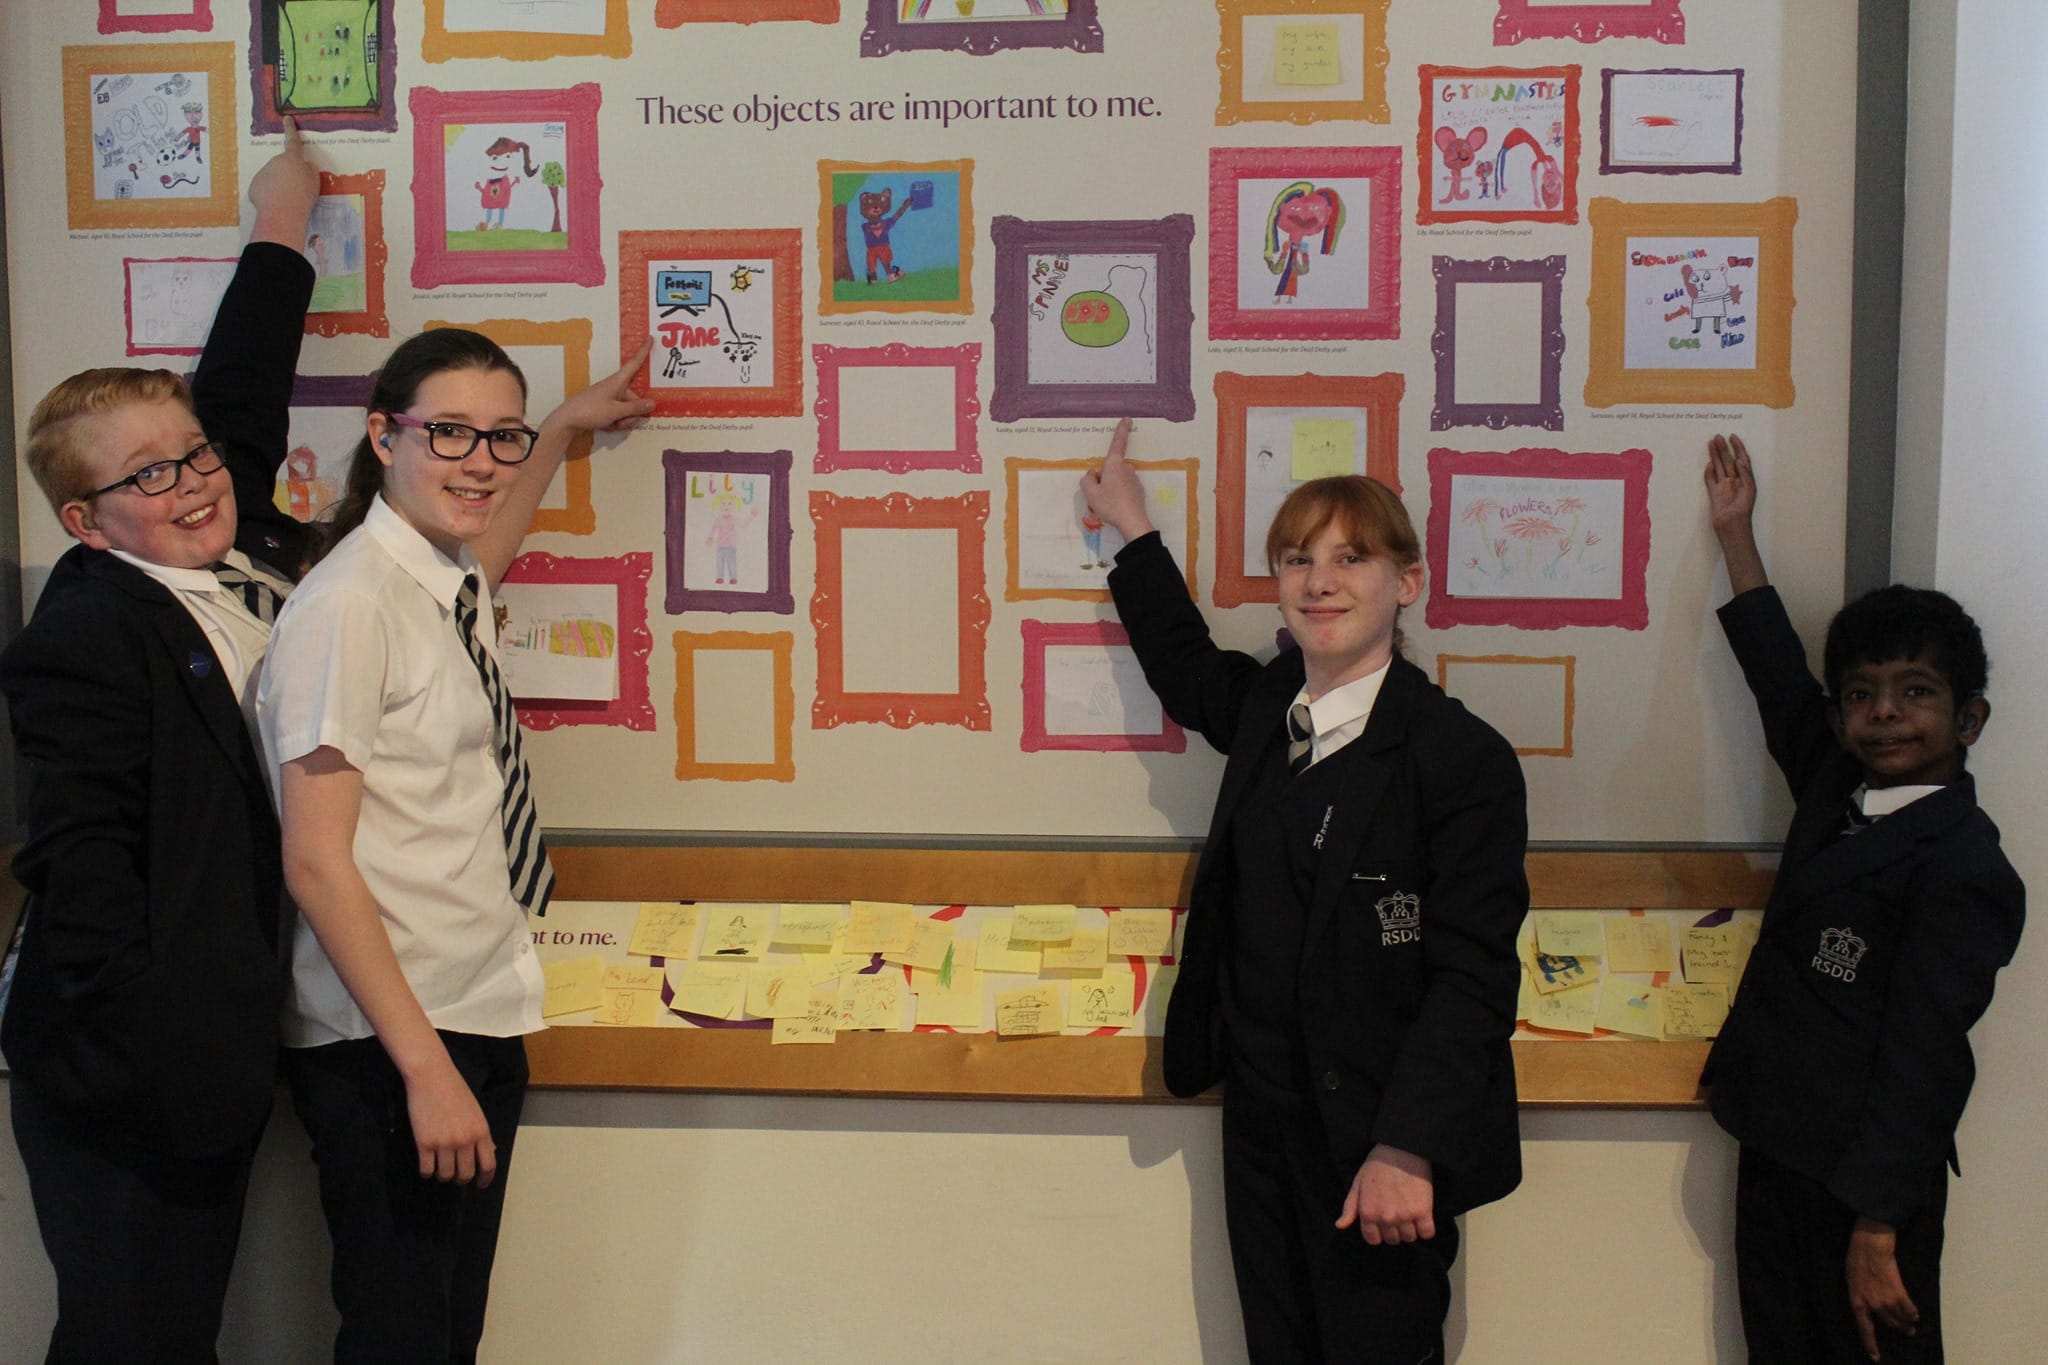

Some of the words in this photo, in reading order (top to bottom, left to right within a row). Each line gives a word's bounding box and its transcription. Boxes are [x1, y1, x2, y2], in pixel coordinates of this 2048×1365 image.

[636, 96, 724, 125] These
[733, 94, 840, 131] objects
[849, 101, 895, 121] are
[905, 92, 1057, 129] important
[1066, 94, 1098, 118] to
[1107, 97, 1162, 117] me.
[553, 931, 574, 945] to
[579, 932, 617, 946] me.
[1812, 956, 1856, 982] RSDD
